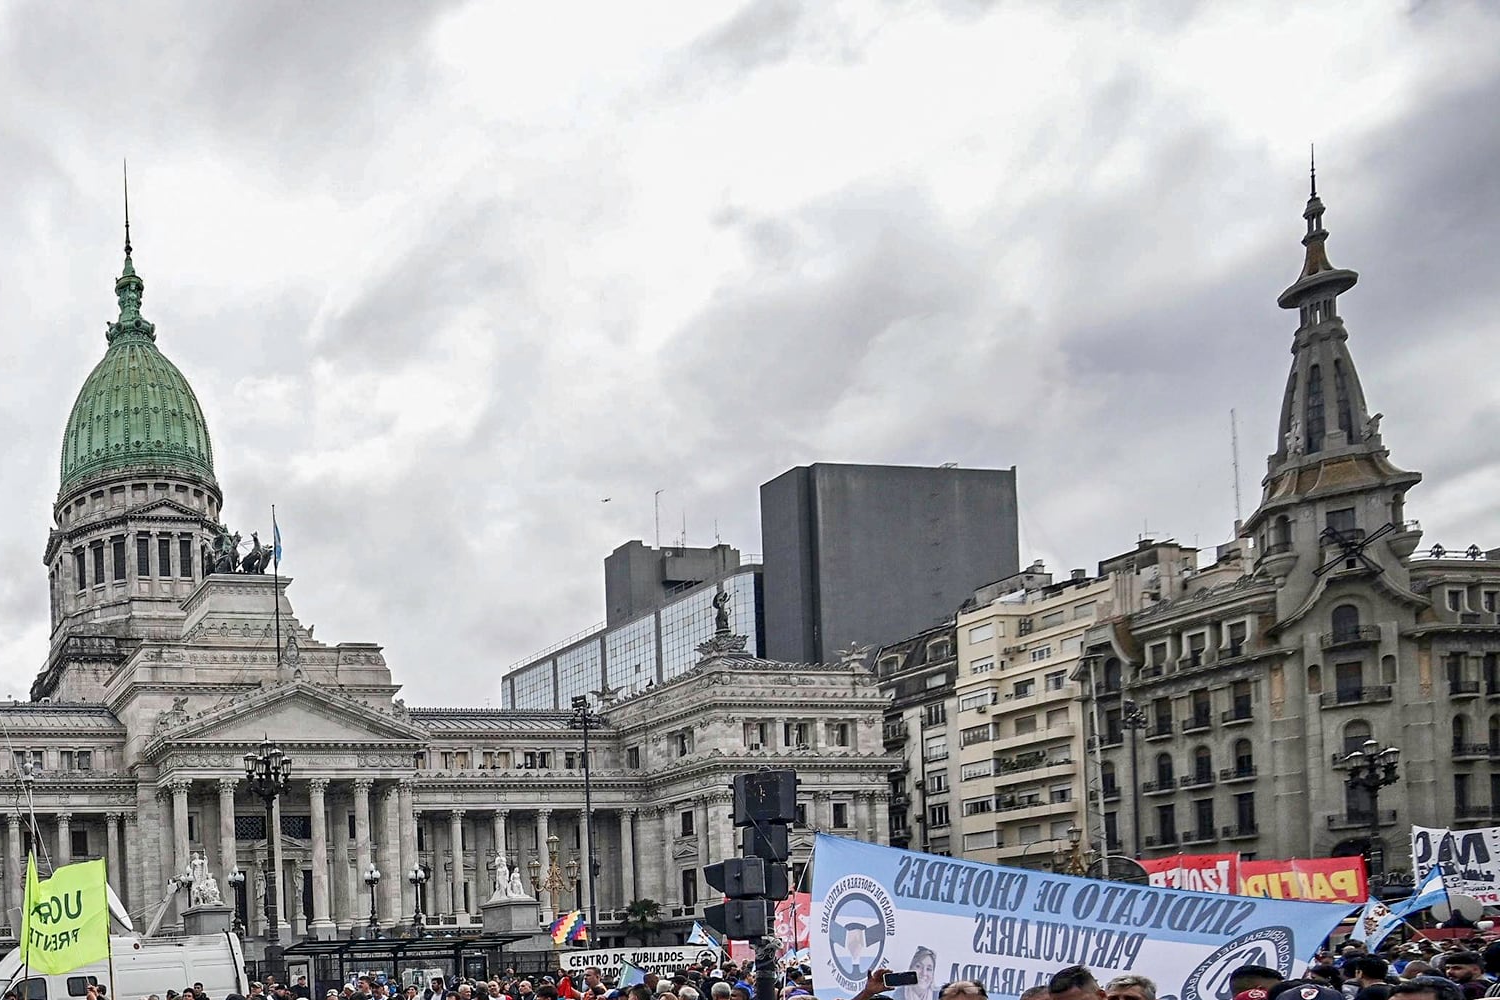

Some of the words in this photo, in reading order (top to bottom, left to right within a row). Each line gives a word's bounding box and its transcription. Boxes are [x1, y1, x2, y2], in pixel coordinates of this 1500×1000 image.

[570, 954, 609, 967] CENTRO
[613, 954, 625, 963] DE
[631, 951, 685, 963] JUBILADOS
